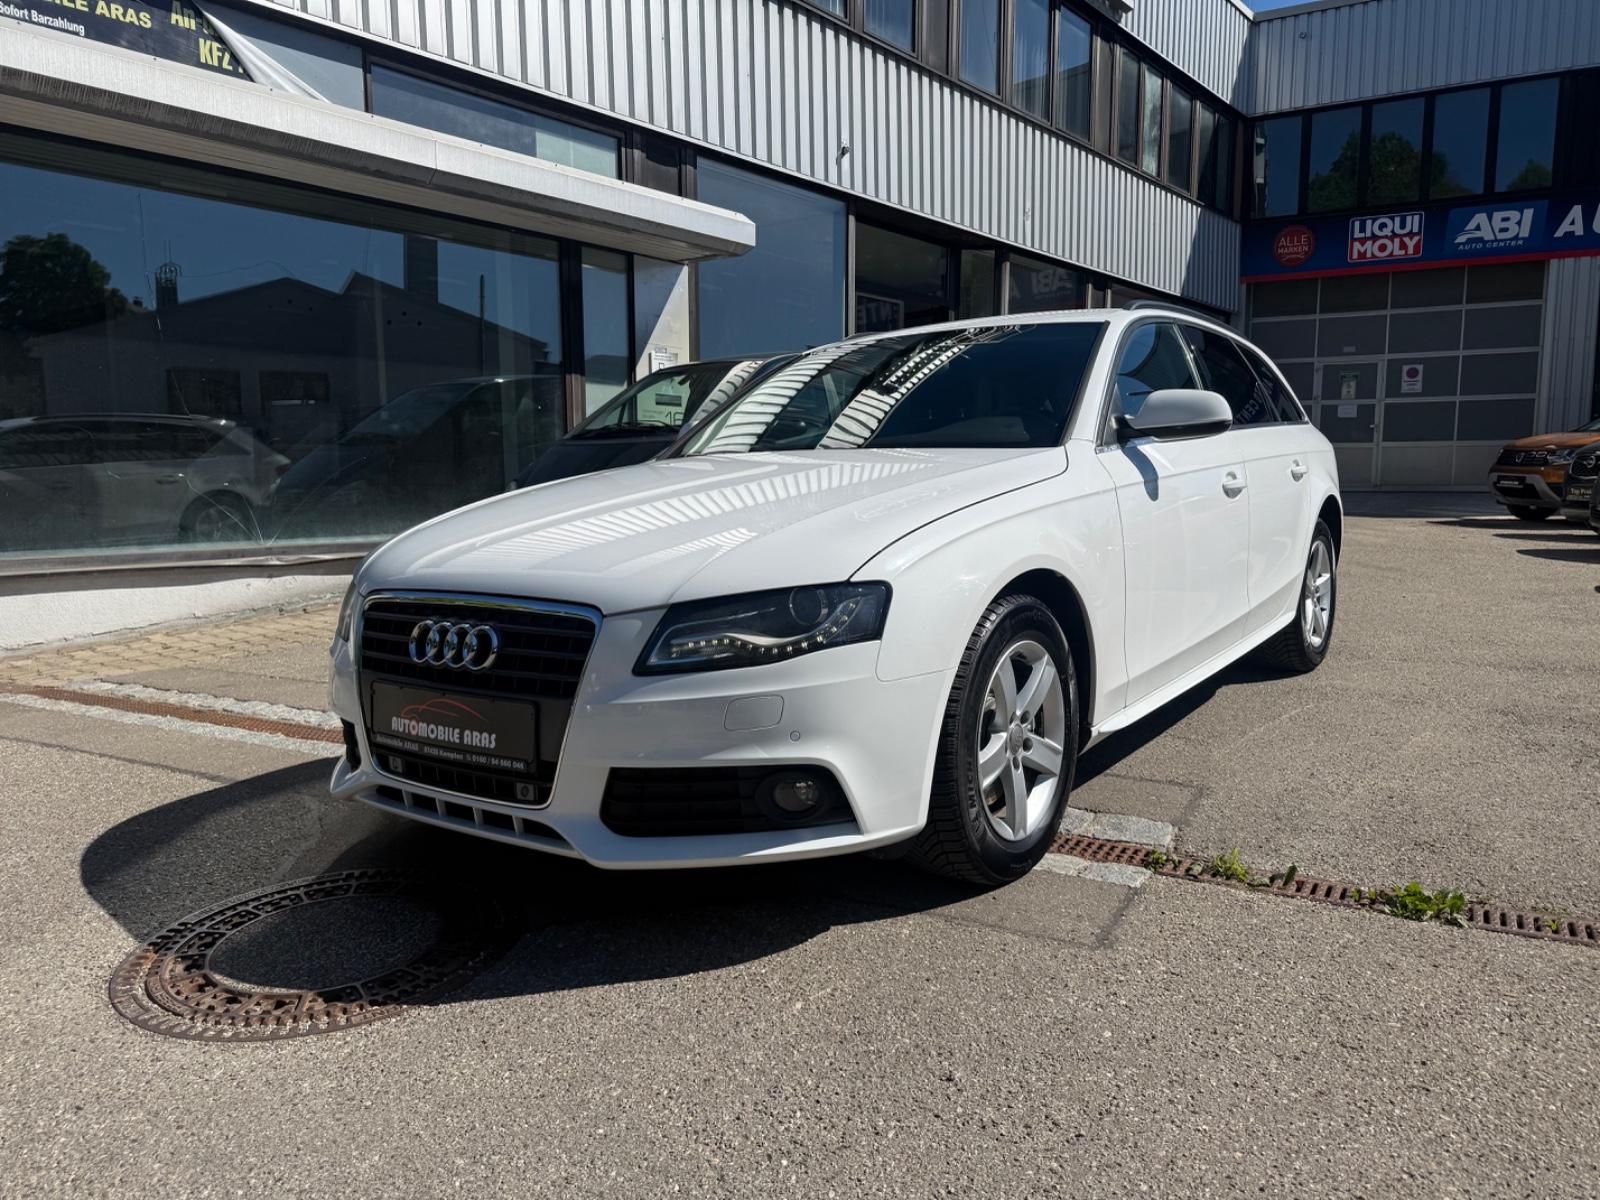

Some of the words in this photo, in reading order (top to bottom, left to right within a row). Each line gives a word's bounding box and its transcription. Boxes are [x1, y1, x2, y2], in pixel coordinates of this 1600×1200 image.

[0, 2, 29, 20] Sofort
[30, 10, 85, 36] Barzahlung
[95, 0, 152, 29] ARAS
[1353, 214, 1420, 238] LIQUI
[1454, 207, 1535, 244] ABI
[1278, 234, 1308, 248] ALLE
[1352, 235, 1420, 260] MOLY
[1457, 242, 1483, 251] AUTO
[1486, 239, 1525, 249] CENTER
[391, 716, 460, 744] AUTOMOBILE
[463, 729, 497, 749] ARAS
